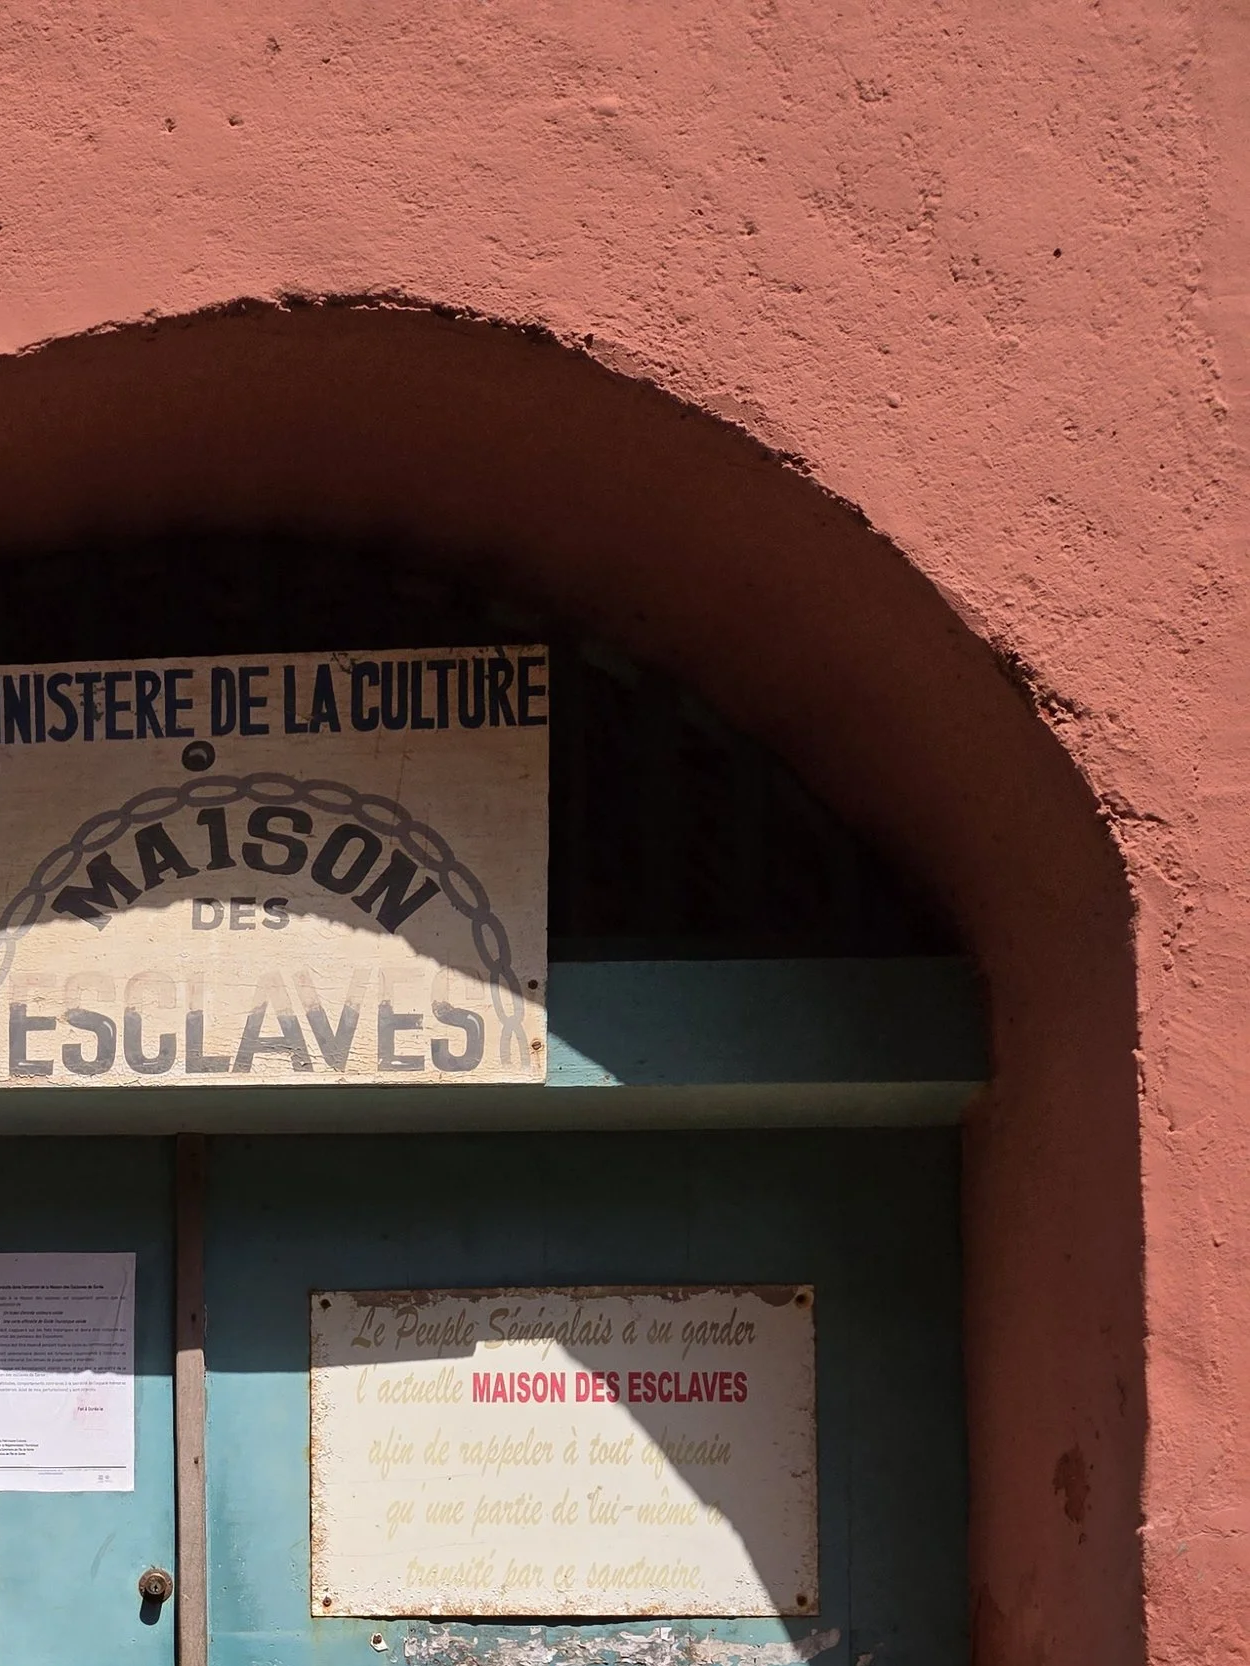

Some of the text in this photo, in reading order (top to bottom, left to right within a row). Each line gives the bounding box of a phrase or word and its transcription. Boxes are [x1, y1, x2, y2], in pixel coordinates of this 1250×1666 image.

[211, 666, 269, 736] DE
[284, 664, 341, 734] LA
[350, 656, 547, 731] CULTURE
[51, 806, 441, 934] MAISON
[191, 897, 290, 930] DES
[9, 967, 484, 1076] ESCLAVES
[351, 1306, 387, 1349] Le
[395, 1307, 477, 1357] Peuple
[484, 1307, 613, 1361] Sénégalais
[649, 1318, 673, 1345] su
[682, 1308, 758, 1360] garder
[472, 1371, 566, 1403] MAISON
[575, 1371, 620, 1403] DES
[628, 1371, 748, 1403] ESCLAVES
[368, 1426, 731, 1480] afin de rappeler à tout africain
[471, 1493, 542, 1537] partie
[552, 1487, 578, 1525] de
[588, 1485, 699, 1525] lui-même
[405, 1548, 705, 1589] transité par ce sanctuaire.
